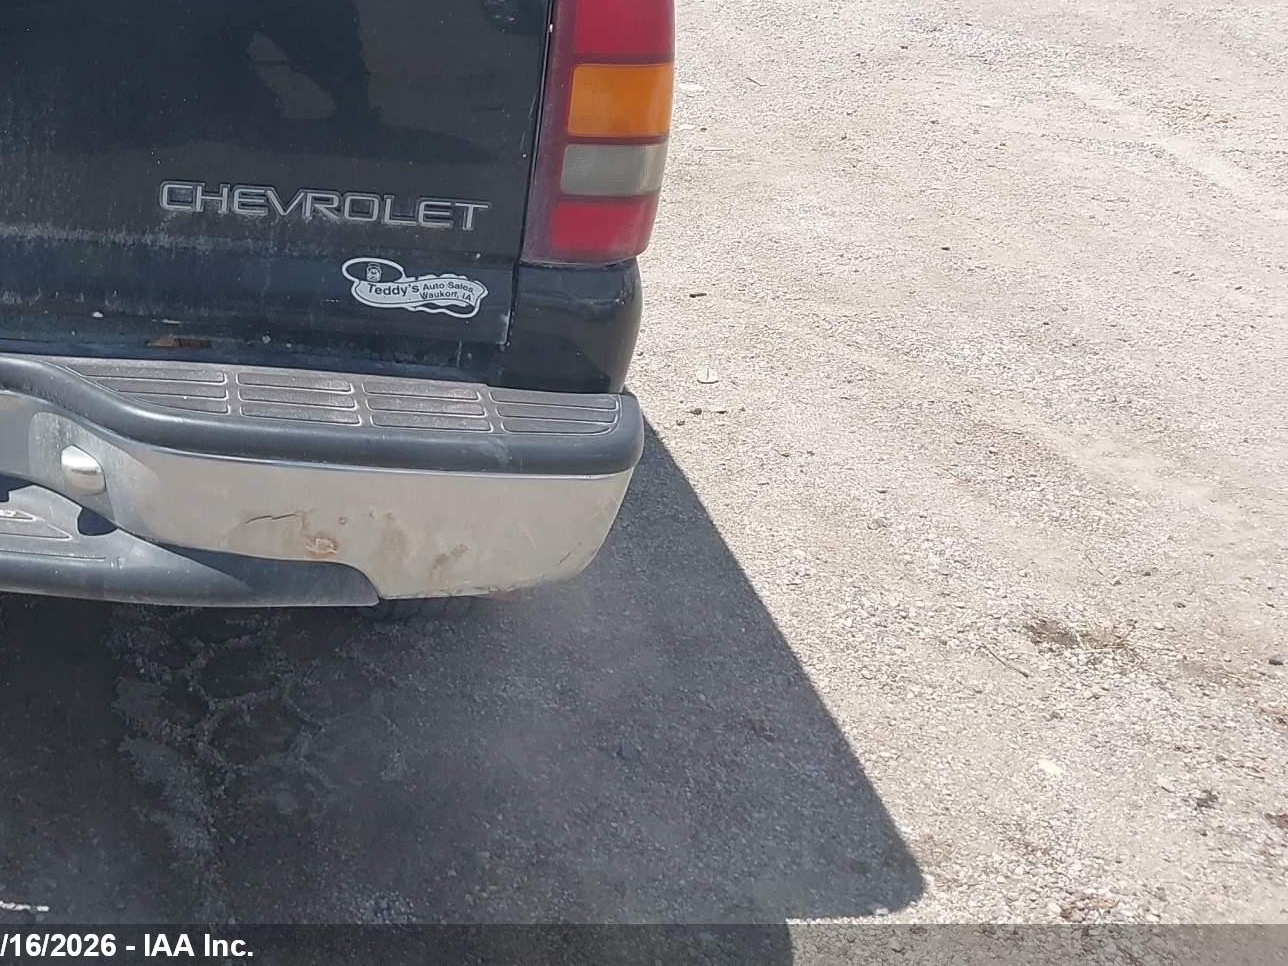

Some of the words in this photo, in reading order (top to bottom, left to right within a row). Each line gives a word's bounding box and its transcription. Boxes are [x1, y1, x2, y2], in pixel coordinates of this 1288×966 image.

[160, 180, 491, 231] CHEVROLET
[368, 283, 419, 297] Teddy's
[423, 283, 445, 291] Auto
[462, 292, 472, 301] IA
